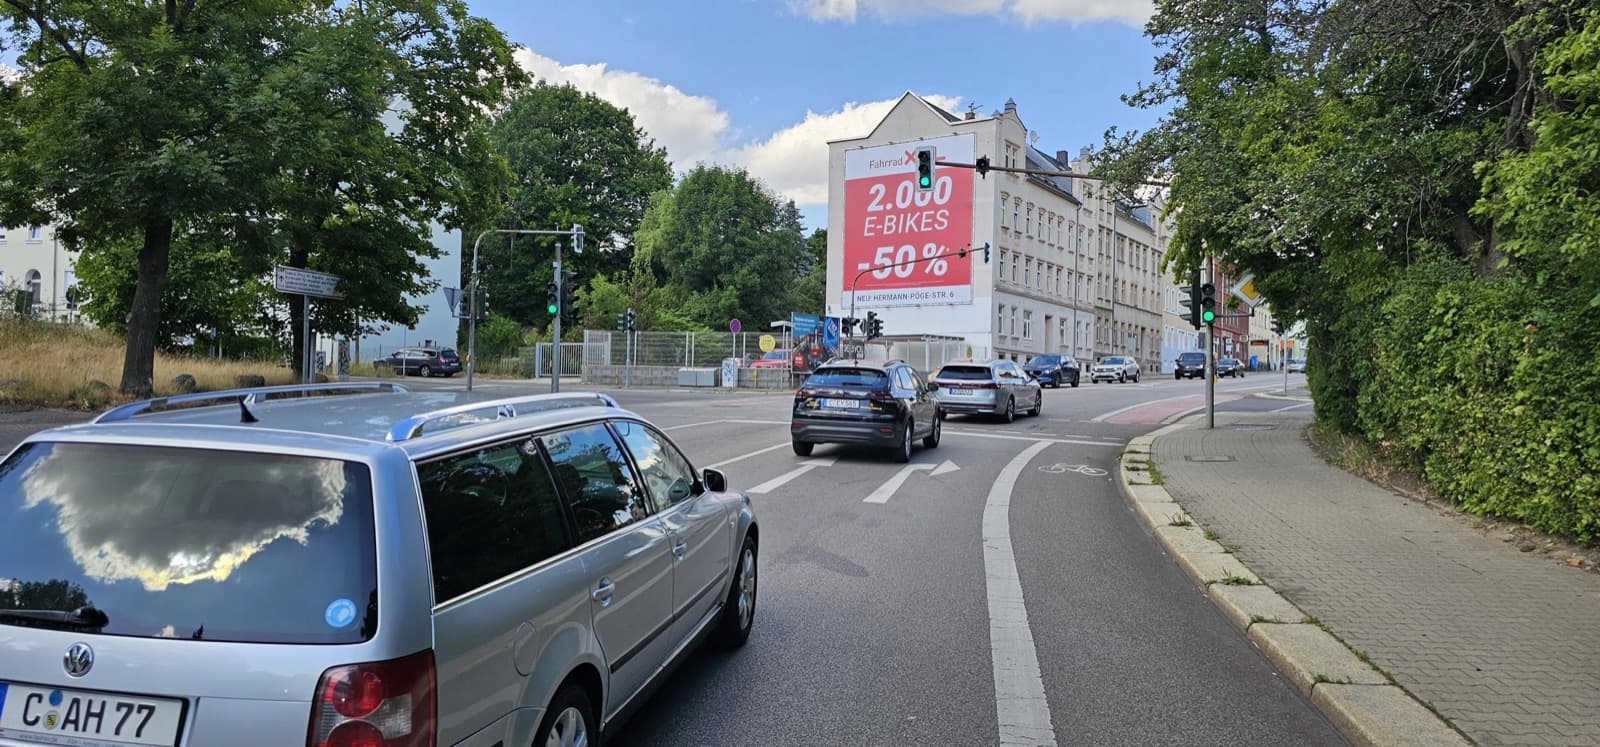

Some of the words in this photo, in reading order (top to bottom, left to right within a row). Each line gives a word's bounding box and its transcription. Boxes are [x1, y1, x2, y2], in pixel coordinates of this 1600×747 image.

[869, 157, 903, 169] Fahrrad
[863, 208, 950, 238] E-BIKES
[22, 692, 43, 727] C
[60, 697, 107, 734] AH
[114, 701, 156, 738] 77
